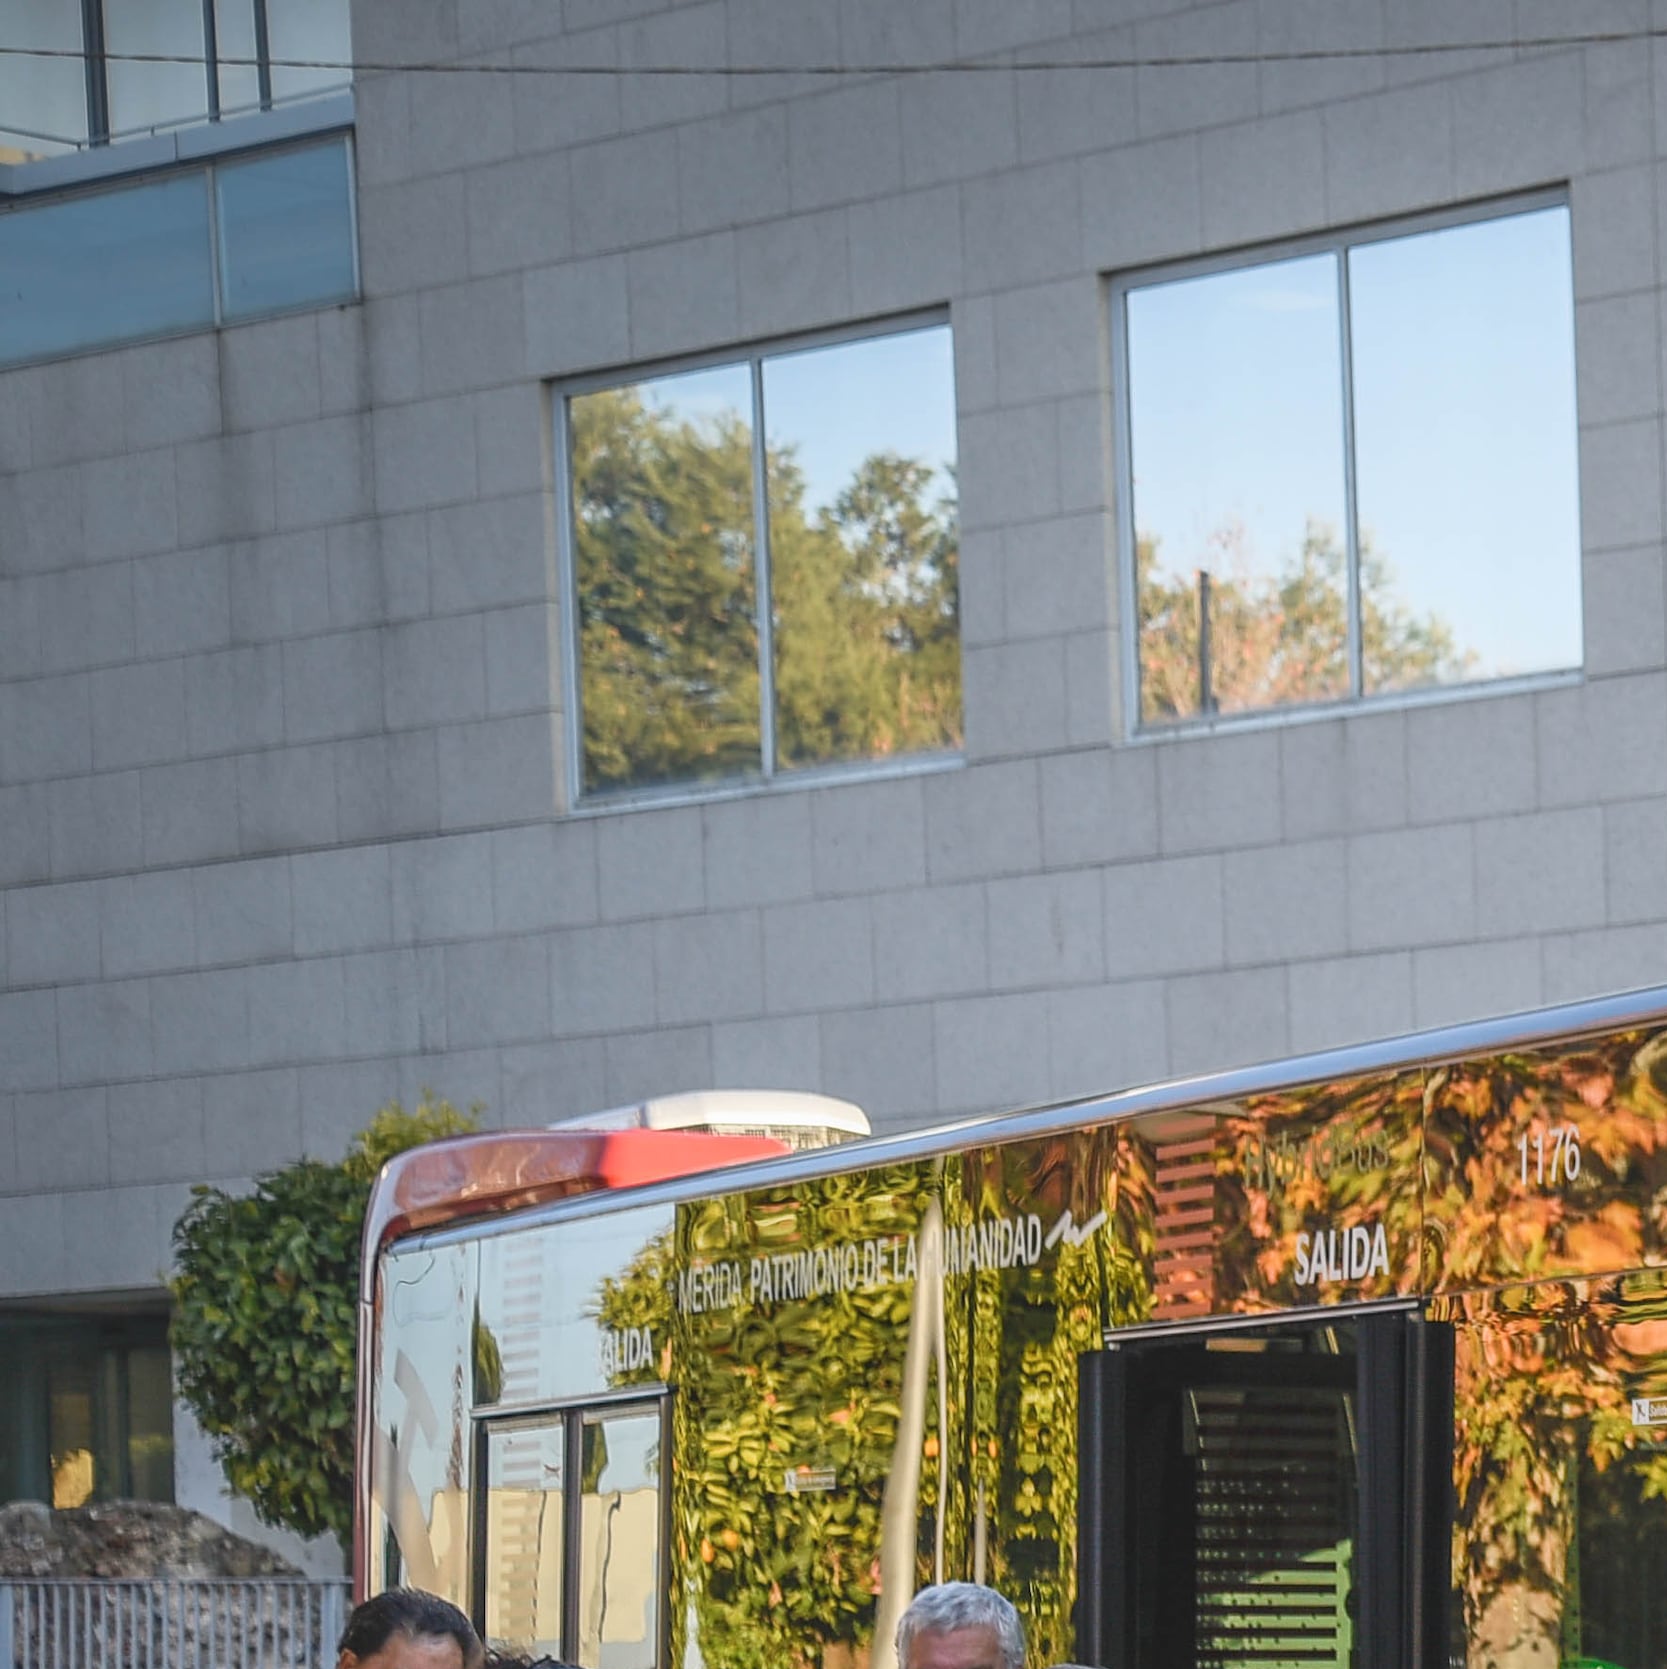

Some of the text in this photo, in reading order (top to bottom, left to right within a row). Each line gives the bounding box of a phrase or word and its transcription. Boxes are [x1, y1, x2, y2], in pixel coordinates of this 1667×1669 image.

[1517, 1123, 1581, 1186] 1176
[750, 1244, 860, 1305] PATRIMONIO
[862, 1240, 889, 1286] DE
[893, 1233, 919, 1281] LA
[1293, 1222, 1391, 1287] SALIDA
